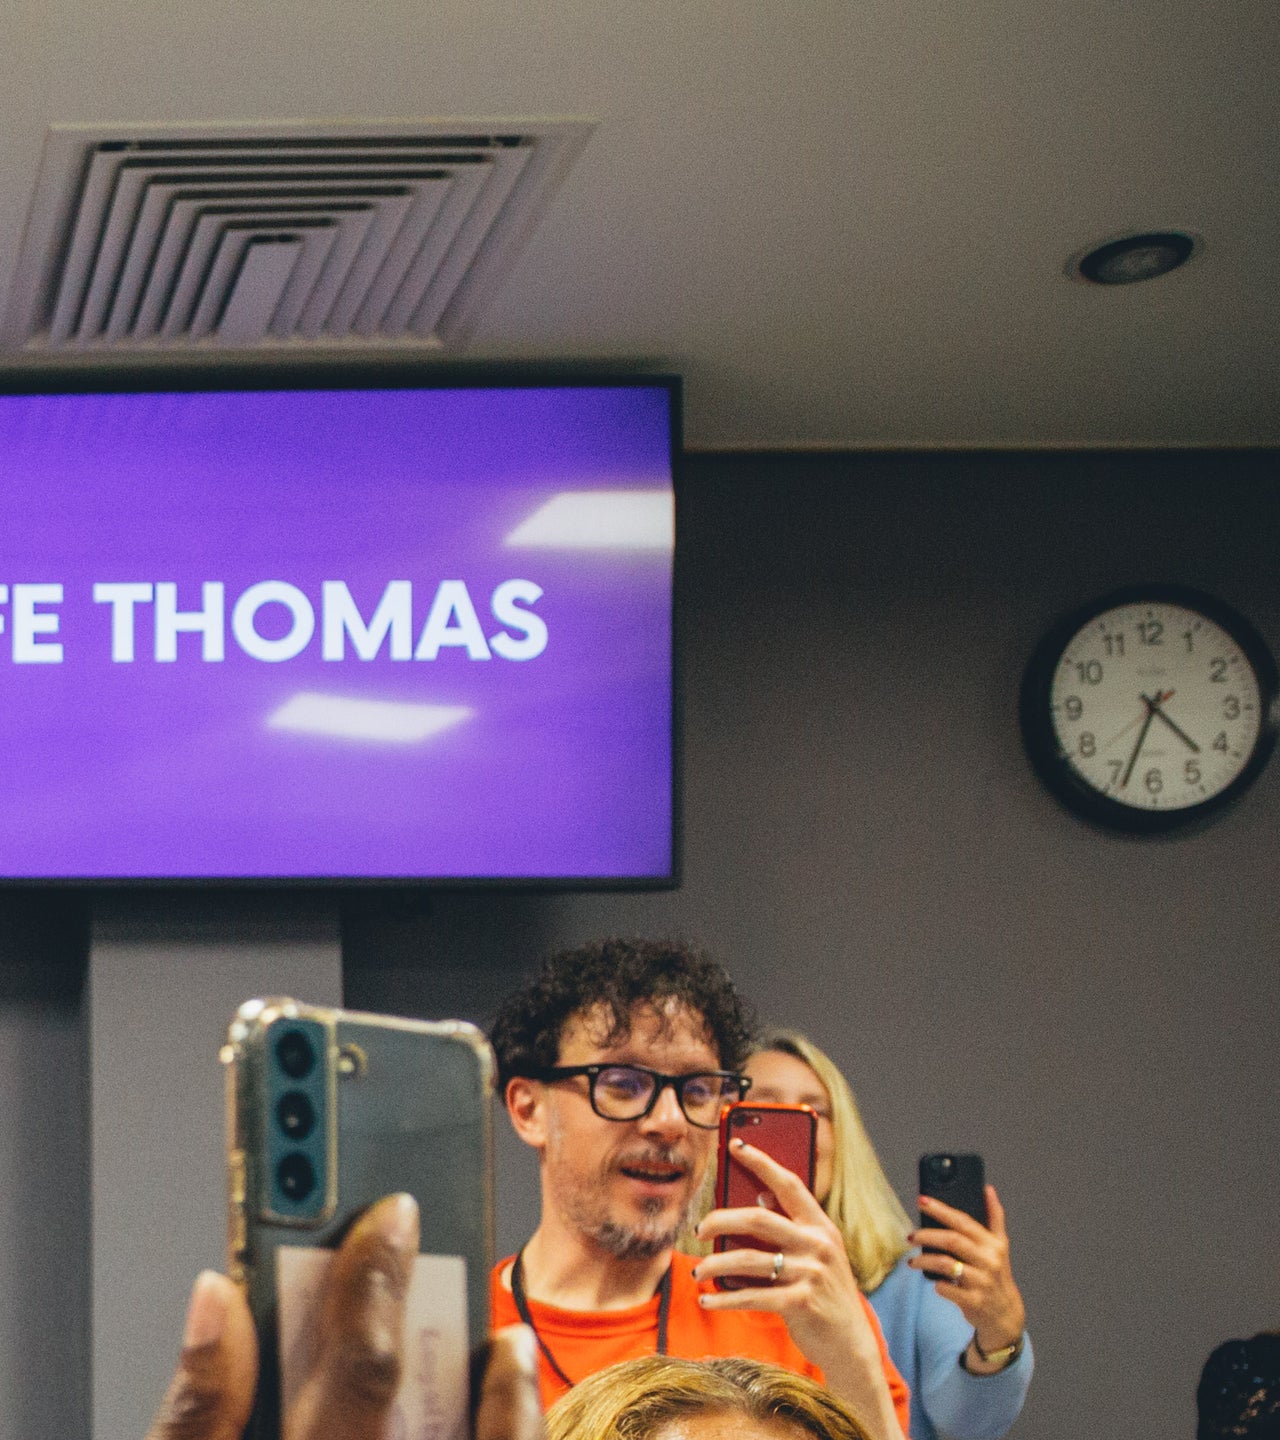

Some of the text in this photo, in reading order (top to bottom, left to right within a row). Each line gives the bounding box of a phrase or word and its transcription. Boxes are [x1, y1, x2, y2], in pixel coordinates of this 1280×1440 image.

[94, 579, 548, 663] THOMAS
[1138, 621, 1164, 645] 12
[1103, 632, 1126, 656] 11
[1183, 631, 1194, 652] 1
[1076, 659, 1103, 685] 10
[1209, 656, 1228, 682] 2
[1063, 695, 1083, 721] 9
[1223, 694, 1240, 720] 3
[1078, 731, 1096, 758] 8
[1212, 731, 1228, 755] 4
[1107, 759, 1124, 785] 7
[1145, 768, 1163, 794] 6
[1184, 760, 1201, 784] 5
